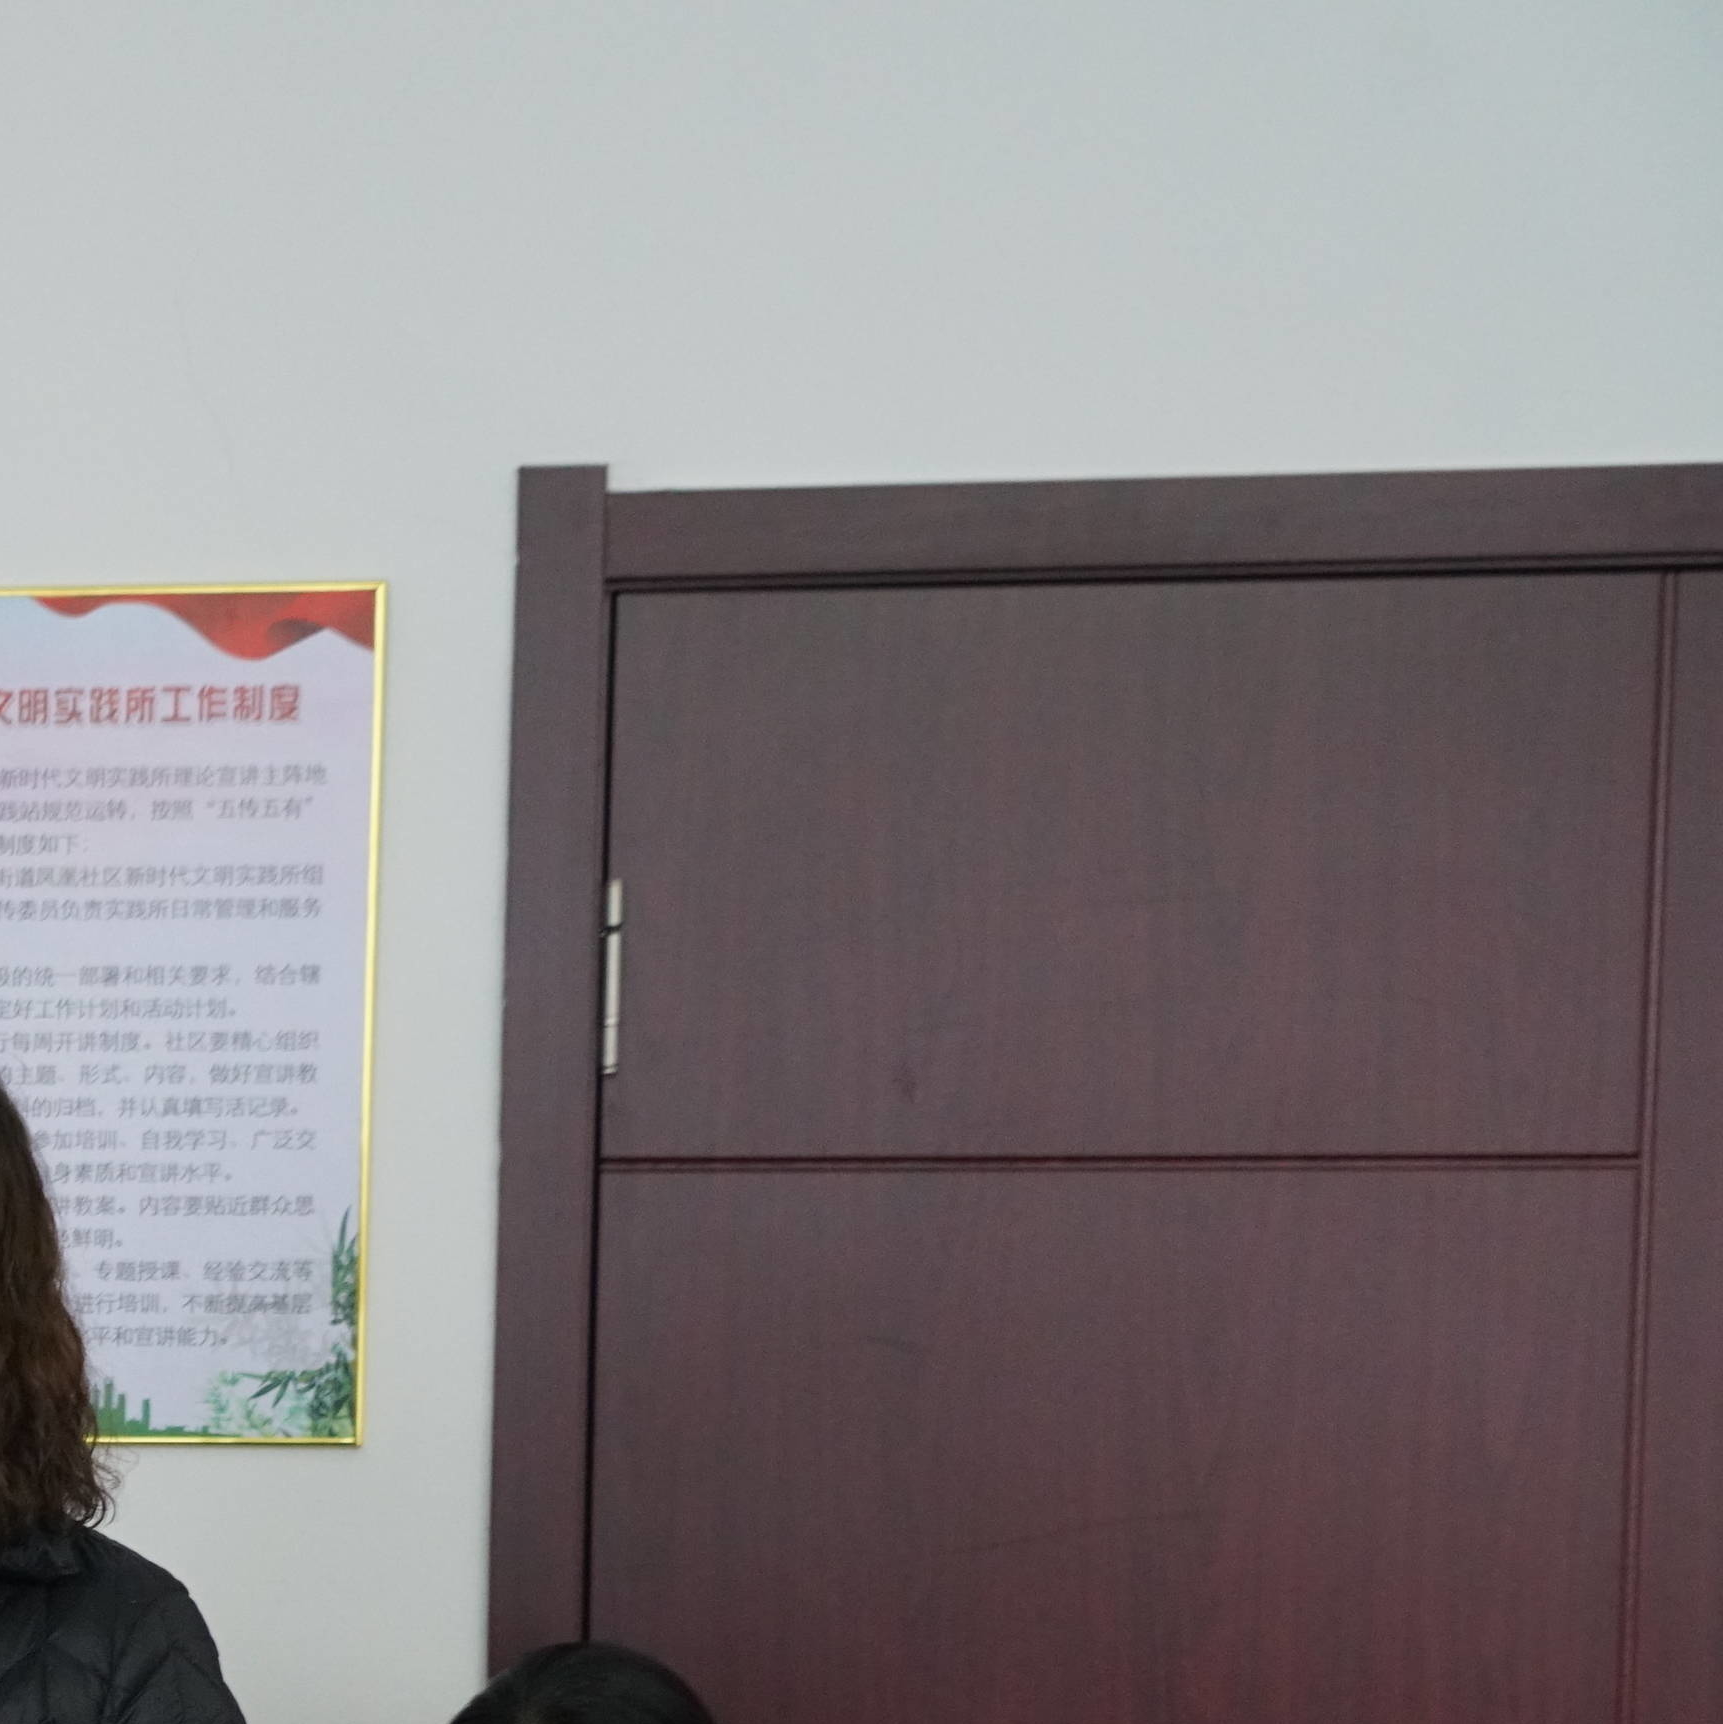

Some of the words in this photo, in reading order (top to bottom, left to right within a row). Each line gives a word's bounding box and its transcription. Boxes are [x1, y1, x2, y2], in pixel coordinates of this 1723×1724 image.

[47, 1162, 231, 1184] 身素质和宣讲水平。
